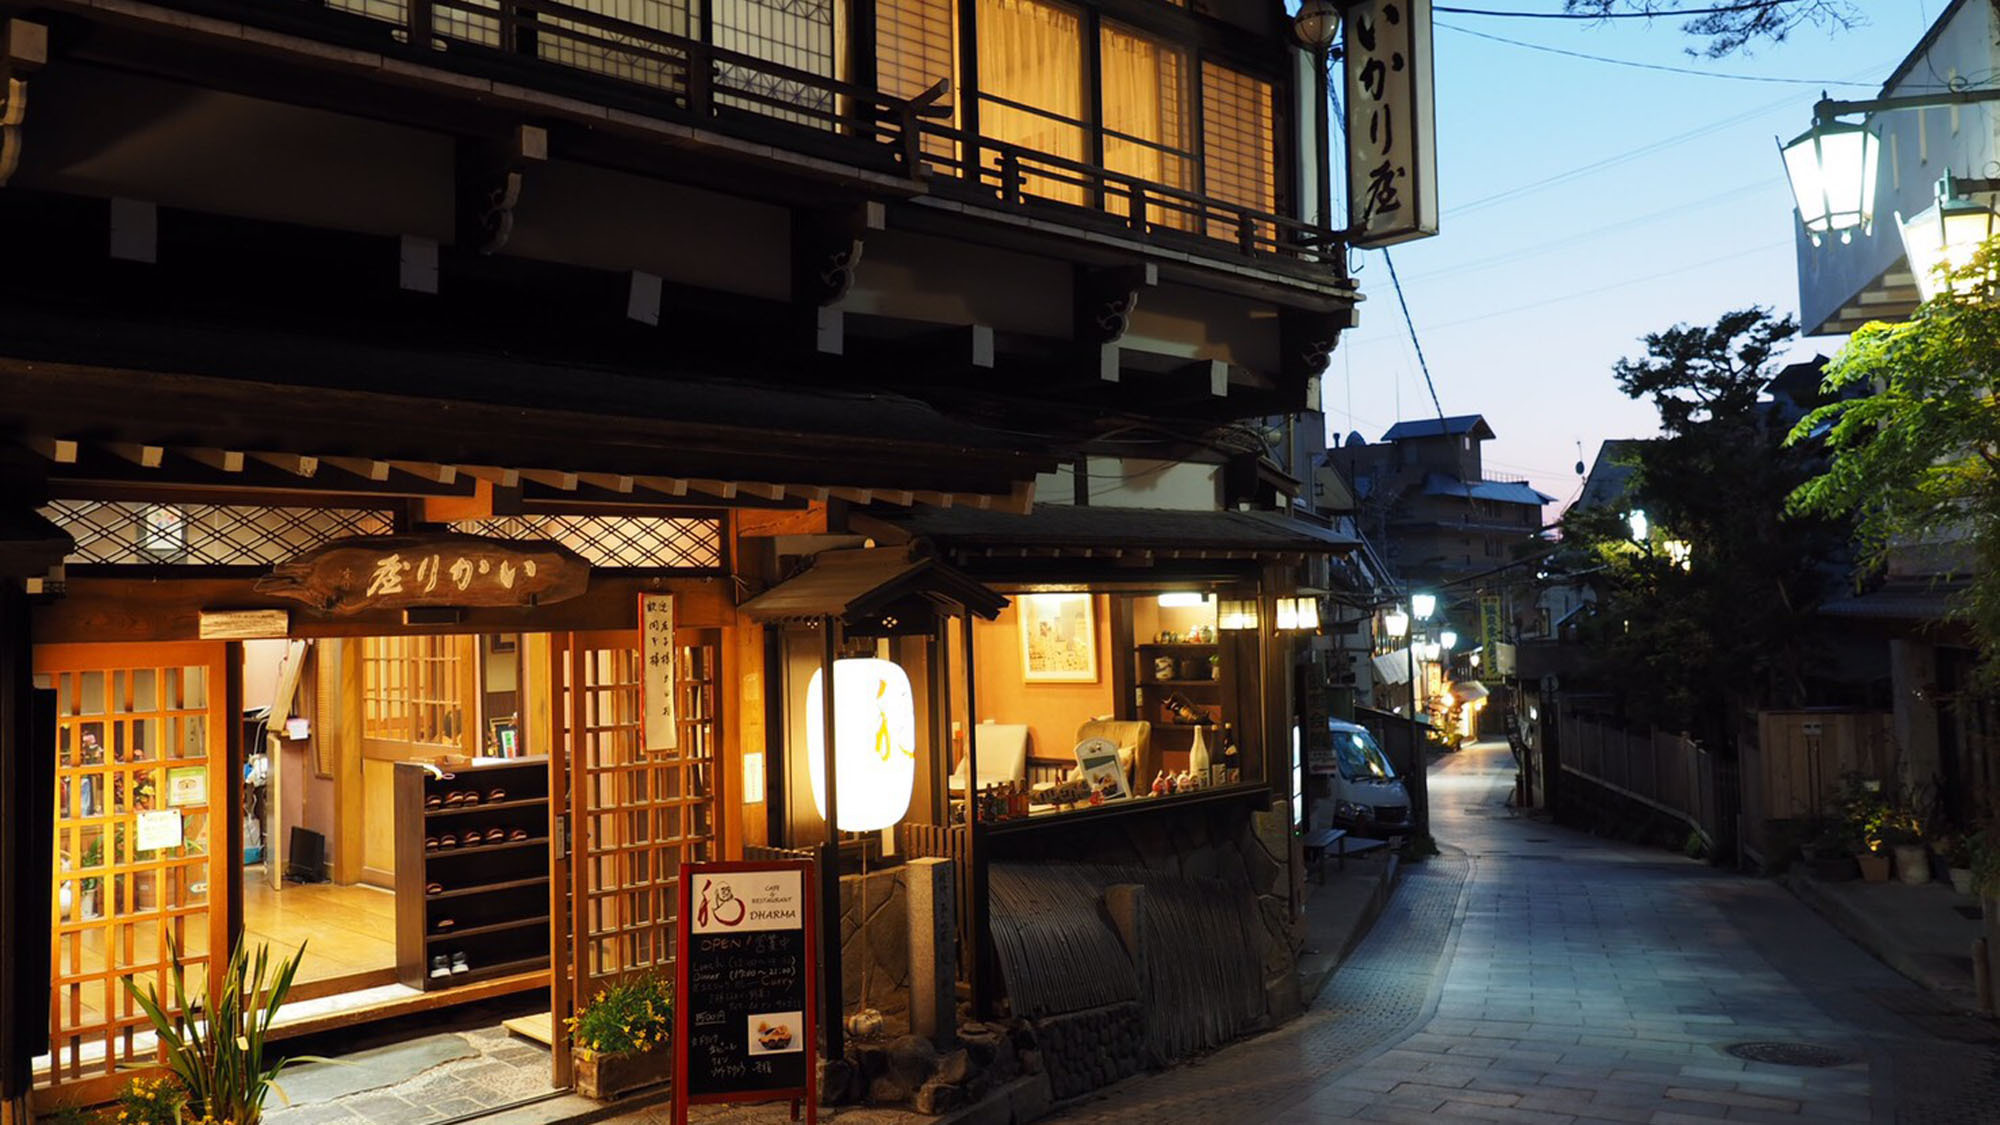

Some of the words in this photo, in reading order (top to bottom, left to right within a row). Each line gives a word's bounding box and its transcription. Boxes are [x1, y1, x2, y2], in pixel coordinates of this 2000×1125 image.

[1357, 3, 1406, 227] いかり屋
[752, 896, 792, 904] RESTAURANT
[750, 910, 796, 920] DHARMA
[701, 938, 741, 952] OPEN
